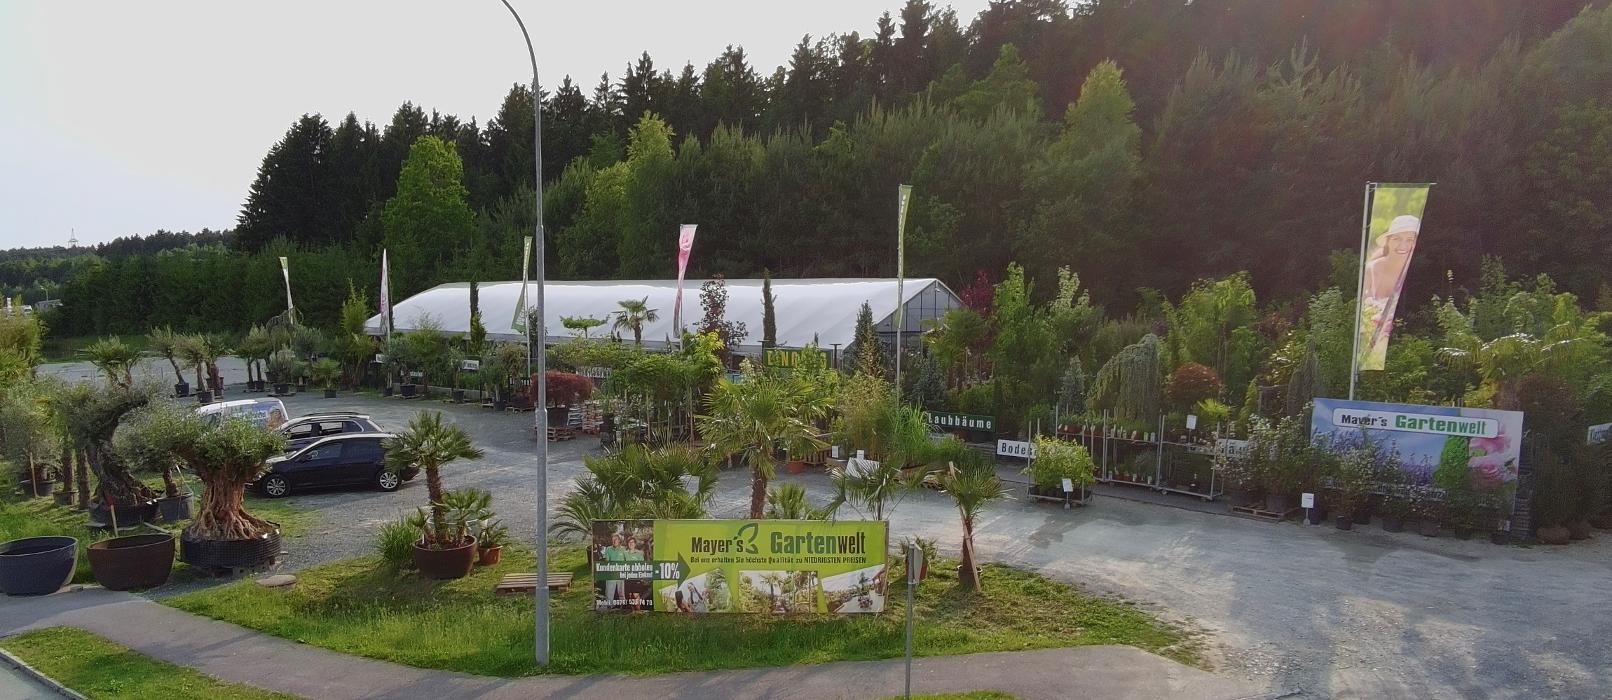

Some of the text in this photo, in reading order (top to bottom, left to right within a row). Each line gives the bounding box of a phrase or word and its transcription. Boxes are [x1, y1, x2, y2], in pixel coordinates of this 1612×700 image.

[928, 412, 992, 429] Laubbäume
[1394, 414, 1487, 434] Gartenwelt
[770, 531, 866, 554] Gartenwelt
[596, 563, 630, 572] Kundenkarte
[768, 556, 793, 564] Qualität
[654, 562, 680, 579] -10%
